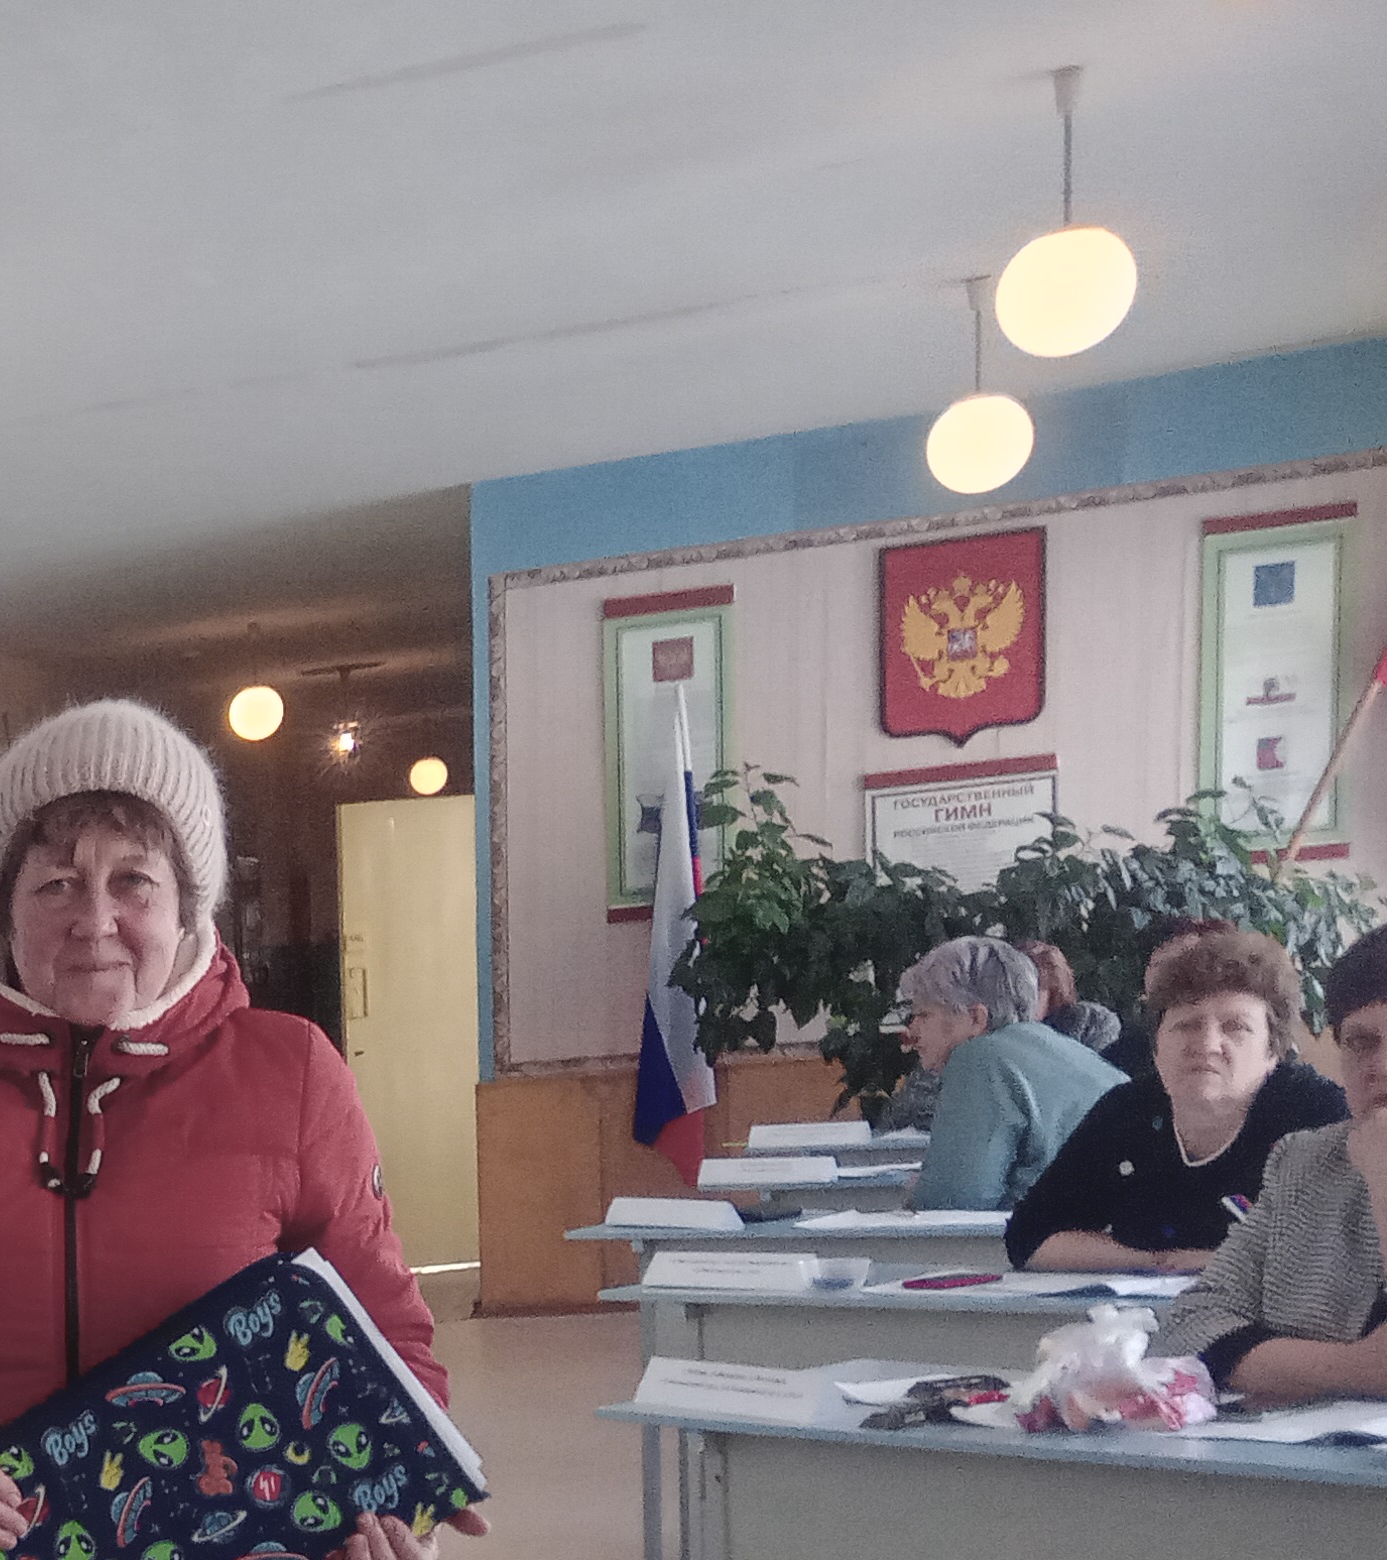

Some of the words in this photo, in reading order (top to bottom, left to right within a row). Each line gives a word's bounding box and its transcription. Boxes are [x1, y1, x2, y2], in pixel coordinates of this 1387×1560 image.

[894, 784, 1034, 810] ГОСУДАРСТВЕННЫЙ
[934, 802, 993, 823] ГИМН
[227, 1292, 282, 1346] Boys
[45, 1409, 98, 1466] Boys
[353, 1463, 408, 1512] Boys
